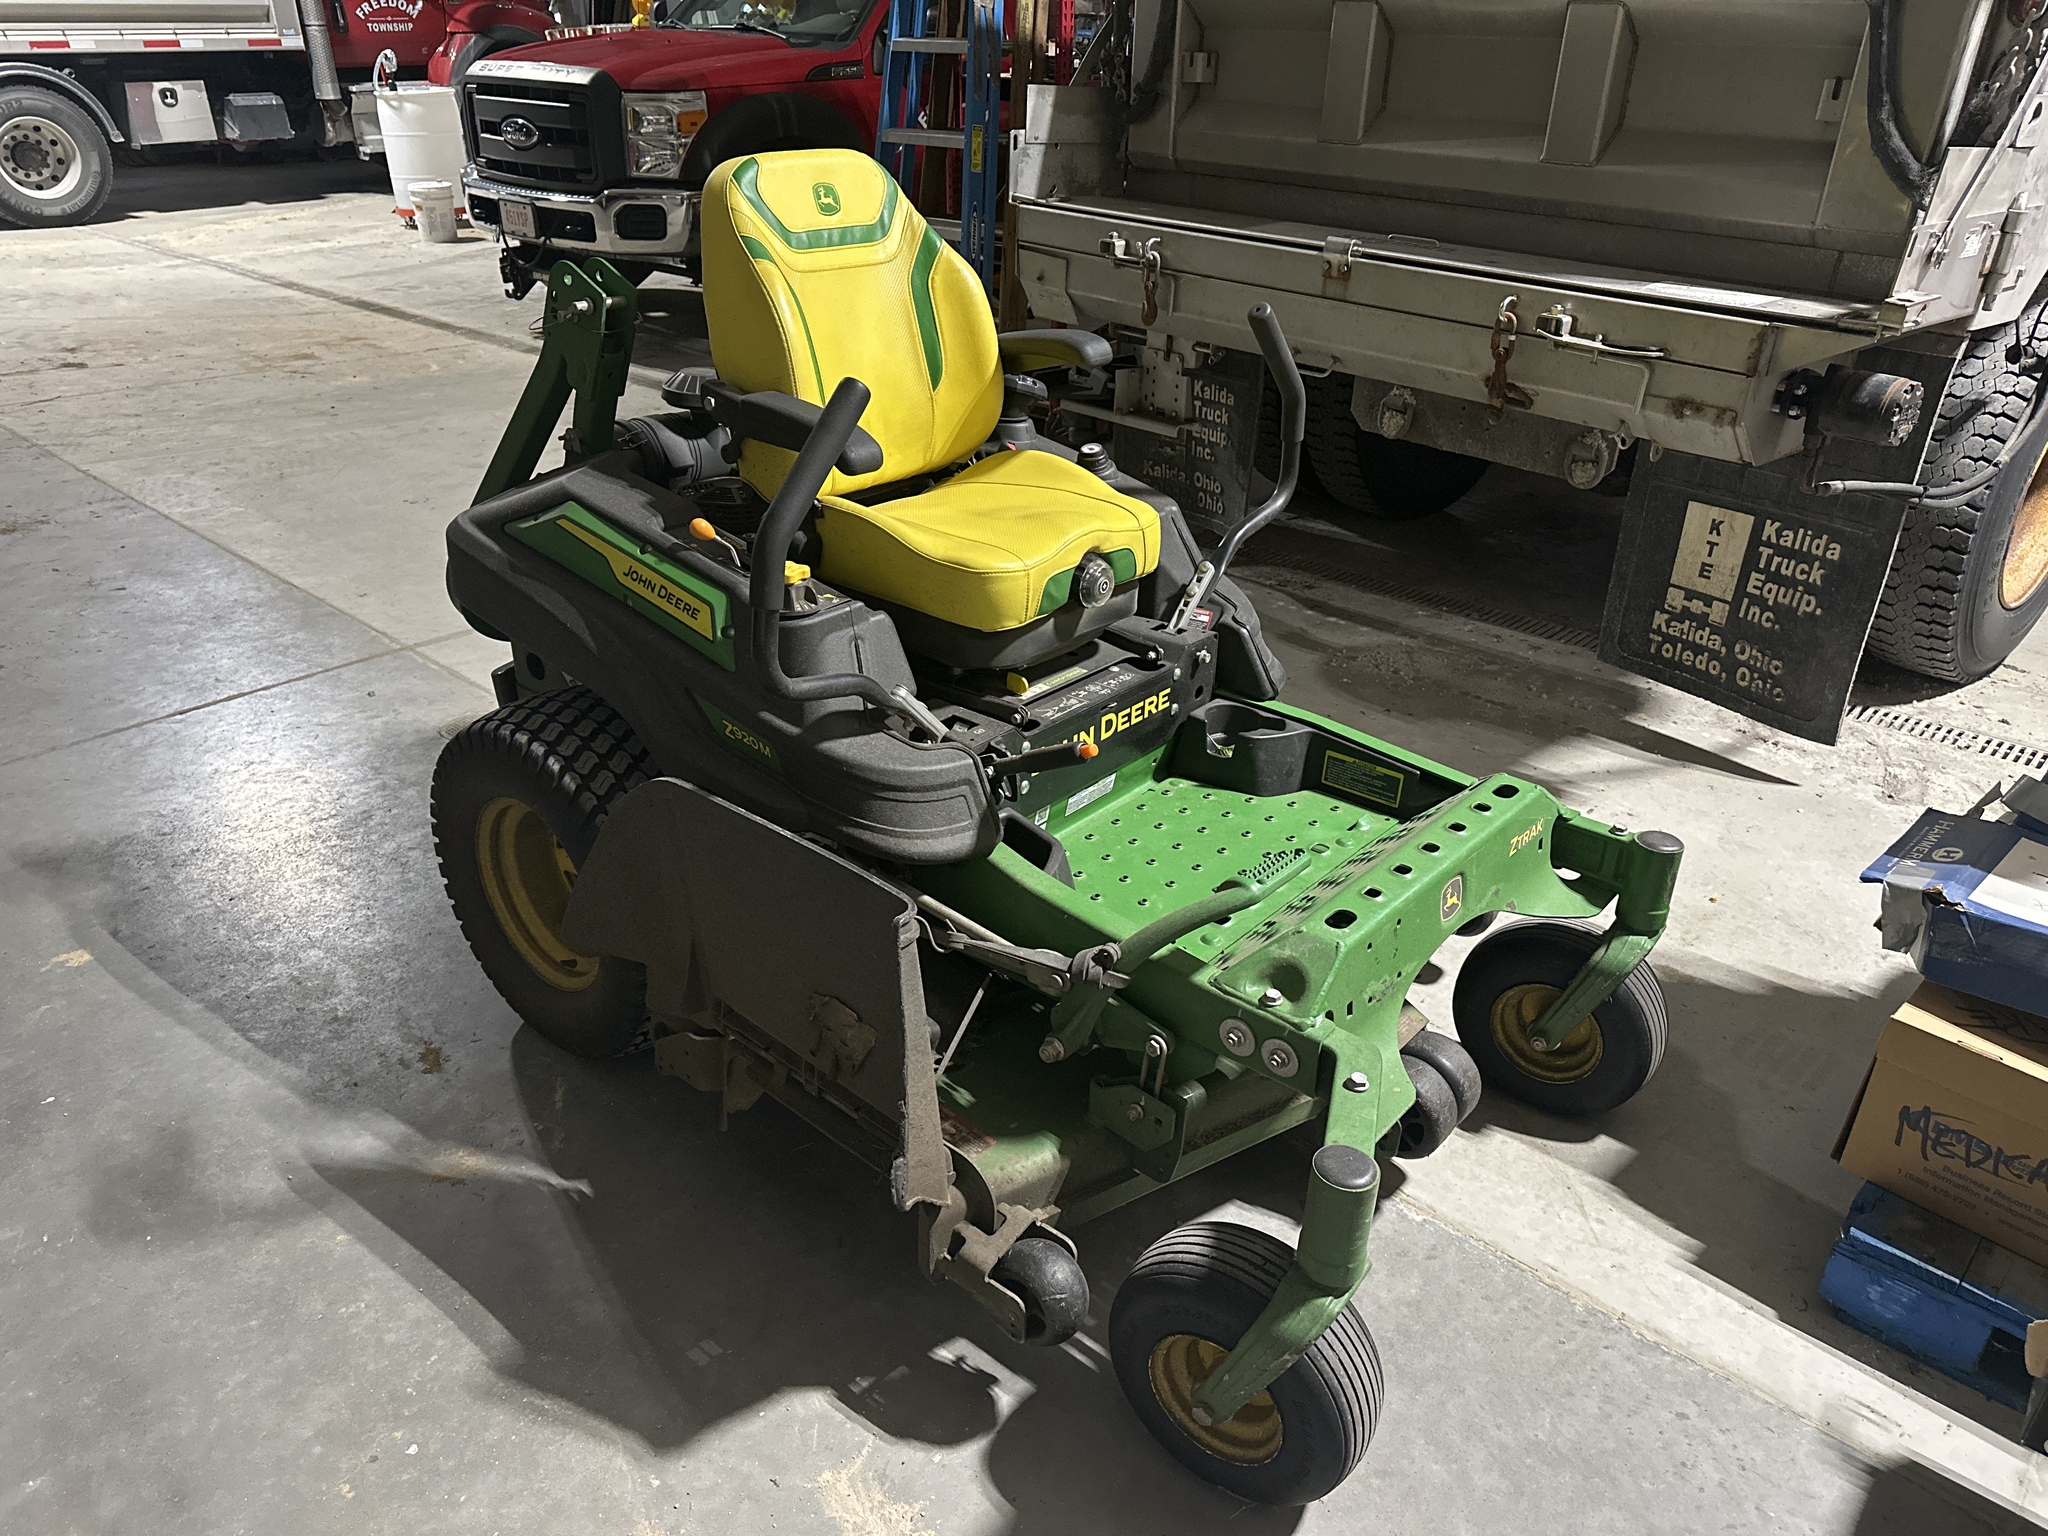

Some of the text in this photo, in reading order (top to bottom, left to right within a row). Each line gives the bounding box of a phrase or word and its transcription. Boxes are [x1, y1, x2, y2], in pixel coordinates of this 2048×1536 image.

[355, 0, 419, 20] FREEDOM
[366, 22, 414, 33] TOWNSHIP
[1193, 379, 1235, 407] Kalida
[1193, 400, 1230, 426] Truck
[1191, 440, 1216, 462] Inc.
[1193, 471, 1222, 494] Ohio
[1197, 491, 1225, 515] Ohio
[1761, 518, 1842, 561] Kalida
[1757, 545, 1826, 586] Truck
[622, 565, 701, 621] JOHN DEERE
[1745, 570, 1823, 616] Equip.
[1738, 597, 1781, 631] Inc.
[1649, 632, 1727, 683] Toledo,
[1651, 610, 1785, 677] Kalida, Ohio
[1100, 687, 1171, 742] DEERE
[721, 719, 772, 759] Z920M
[1508, 816, 1544, 858] ZTRAK
[1922, 1165, 1981, 1201] Information
[1941, 1163, 1991, 1192] Business
